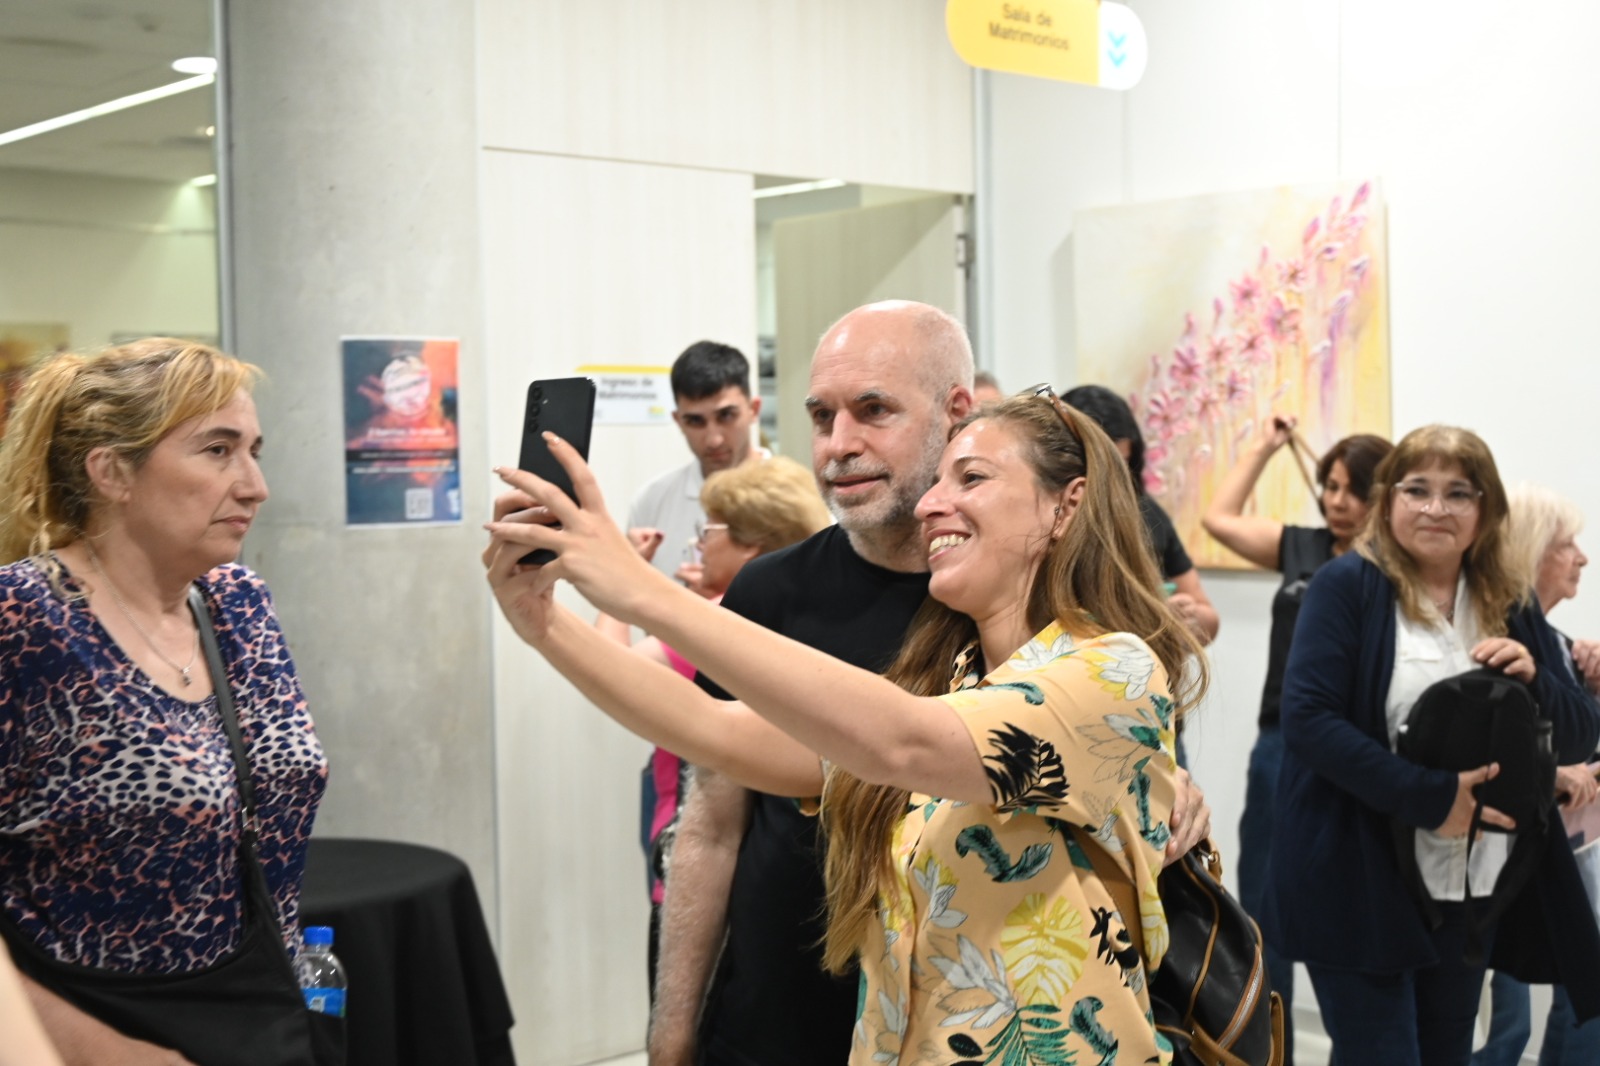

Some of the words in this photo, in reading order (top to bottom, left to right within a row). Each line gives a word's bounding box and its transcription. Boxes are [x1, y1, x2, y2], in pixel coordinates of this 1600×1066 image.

[1002, 3, 1031, 23] Sala
[1036, 10, 1053, 27] de
[988, 22, 1070, 50] Matrimonios
